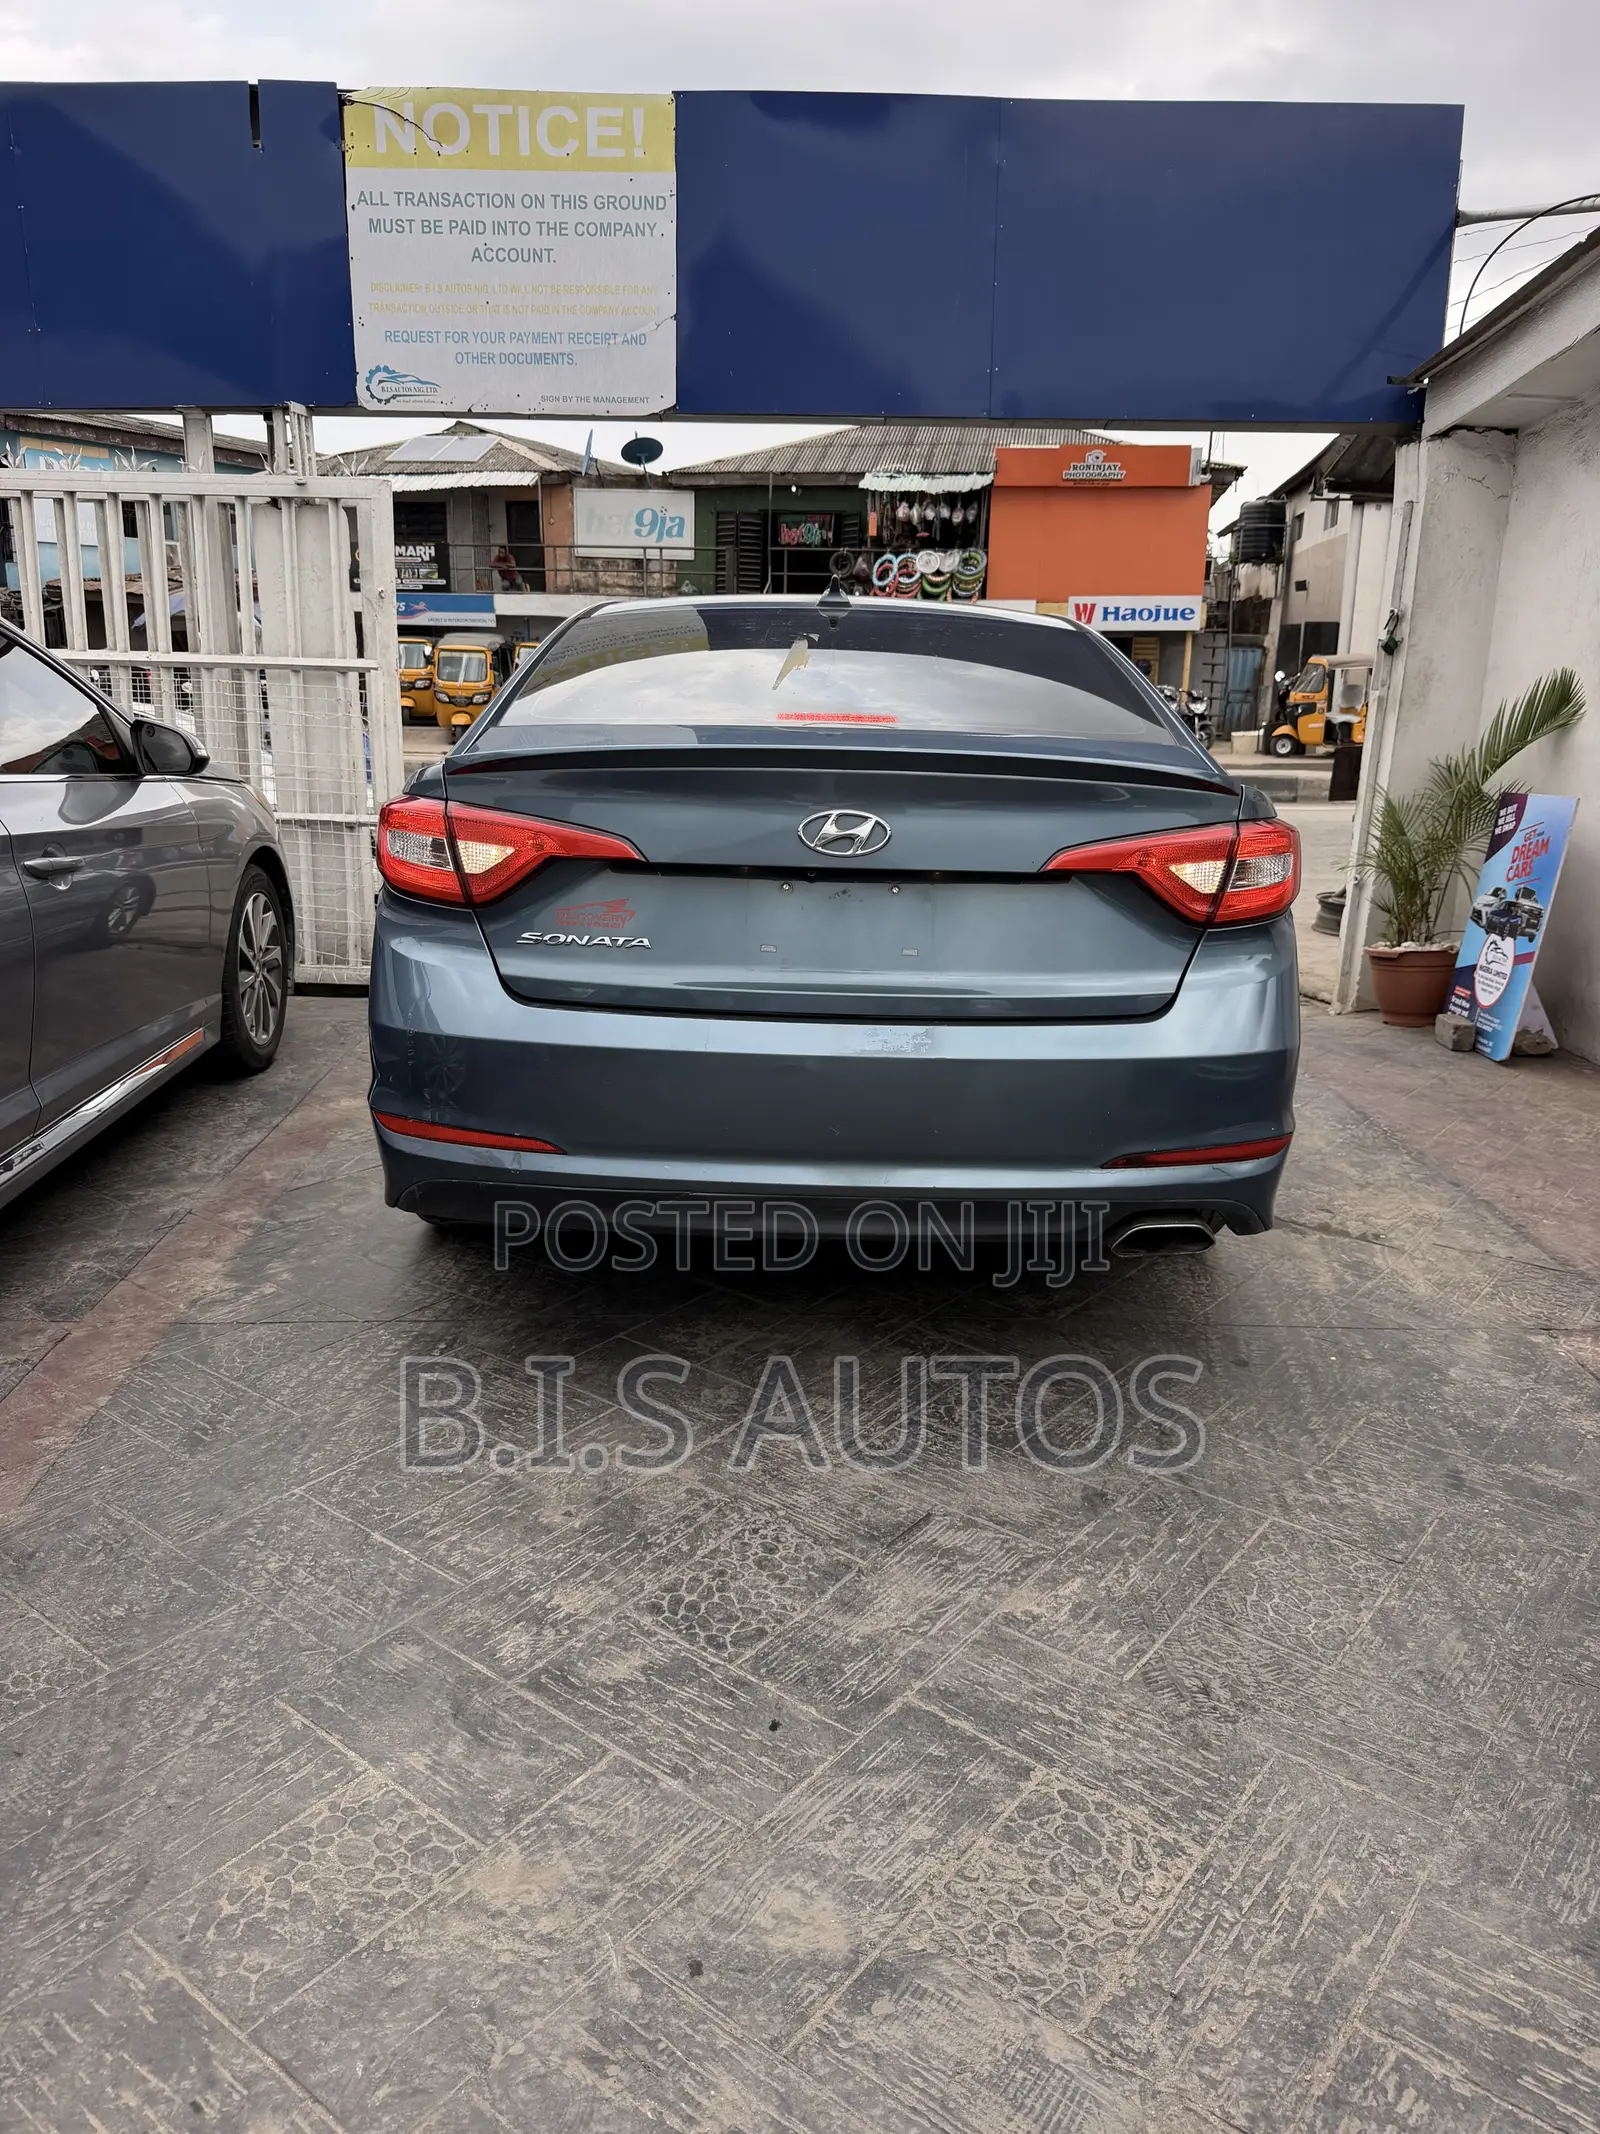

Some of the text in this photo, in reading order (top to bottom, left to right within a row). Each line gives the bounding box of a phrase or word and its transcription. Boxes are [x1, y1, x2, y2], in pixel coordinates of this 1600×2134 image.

[373, 101, 646, 158] NOTICE!
[357, 190, 667, 212] ALL TRANSACTION ON THIS GROUND
[369, 219, 656, 238] MUST BE PAID INTO THE COMPANY
[471, 247, 556, 264] ACCOUNT.
[445, 283, 472, 294] AUTOS
[510, 284, 531, 295] WILL
[531, 285, 549, 295] NOT
[550, 285, 561, 295] BE
[563, 285, 620, 296] RESPONSIBLE
[622, 285, 640, 295] FOR
[640, 285, 659, 295] ANY
[369, 302, 427, 313] TRANSACTION
[429, 303, 463, 314] OUTSIDE
[466, 304, 478, 314] OR
[480, 304, 500, 315] THAT
[503, 304, 511, 315] IS
[512, 305, 529, 315] NOT
[531, 305, 550, 315] PAID
[562, 305, 577, 315] THE
[579, 305, 619, 316] COMPANY
[384, 330, 647, 345] REQUEST FOR YOUR PAYMENT RECEIPT AND
[455, 352, 578, 365] OTHER DOCUMENTS.
[1072, 464, 1119, 472] RONINJAY
[1101, 604, 1196, 623] Haojue
[1499, 808, 1507, 817] WE
[1498, 817, 1505, 825] WE
[1494, 826, 1503, 835] WE
[1524, 829, 1537, 842] GET
[1511, 836, 1551, 864] DREAM
[1506, 859, 1533, 882] CARS
[516, 931, 652, 949] SONATA
